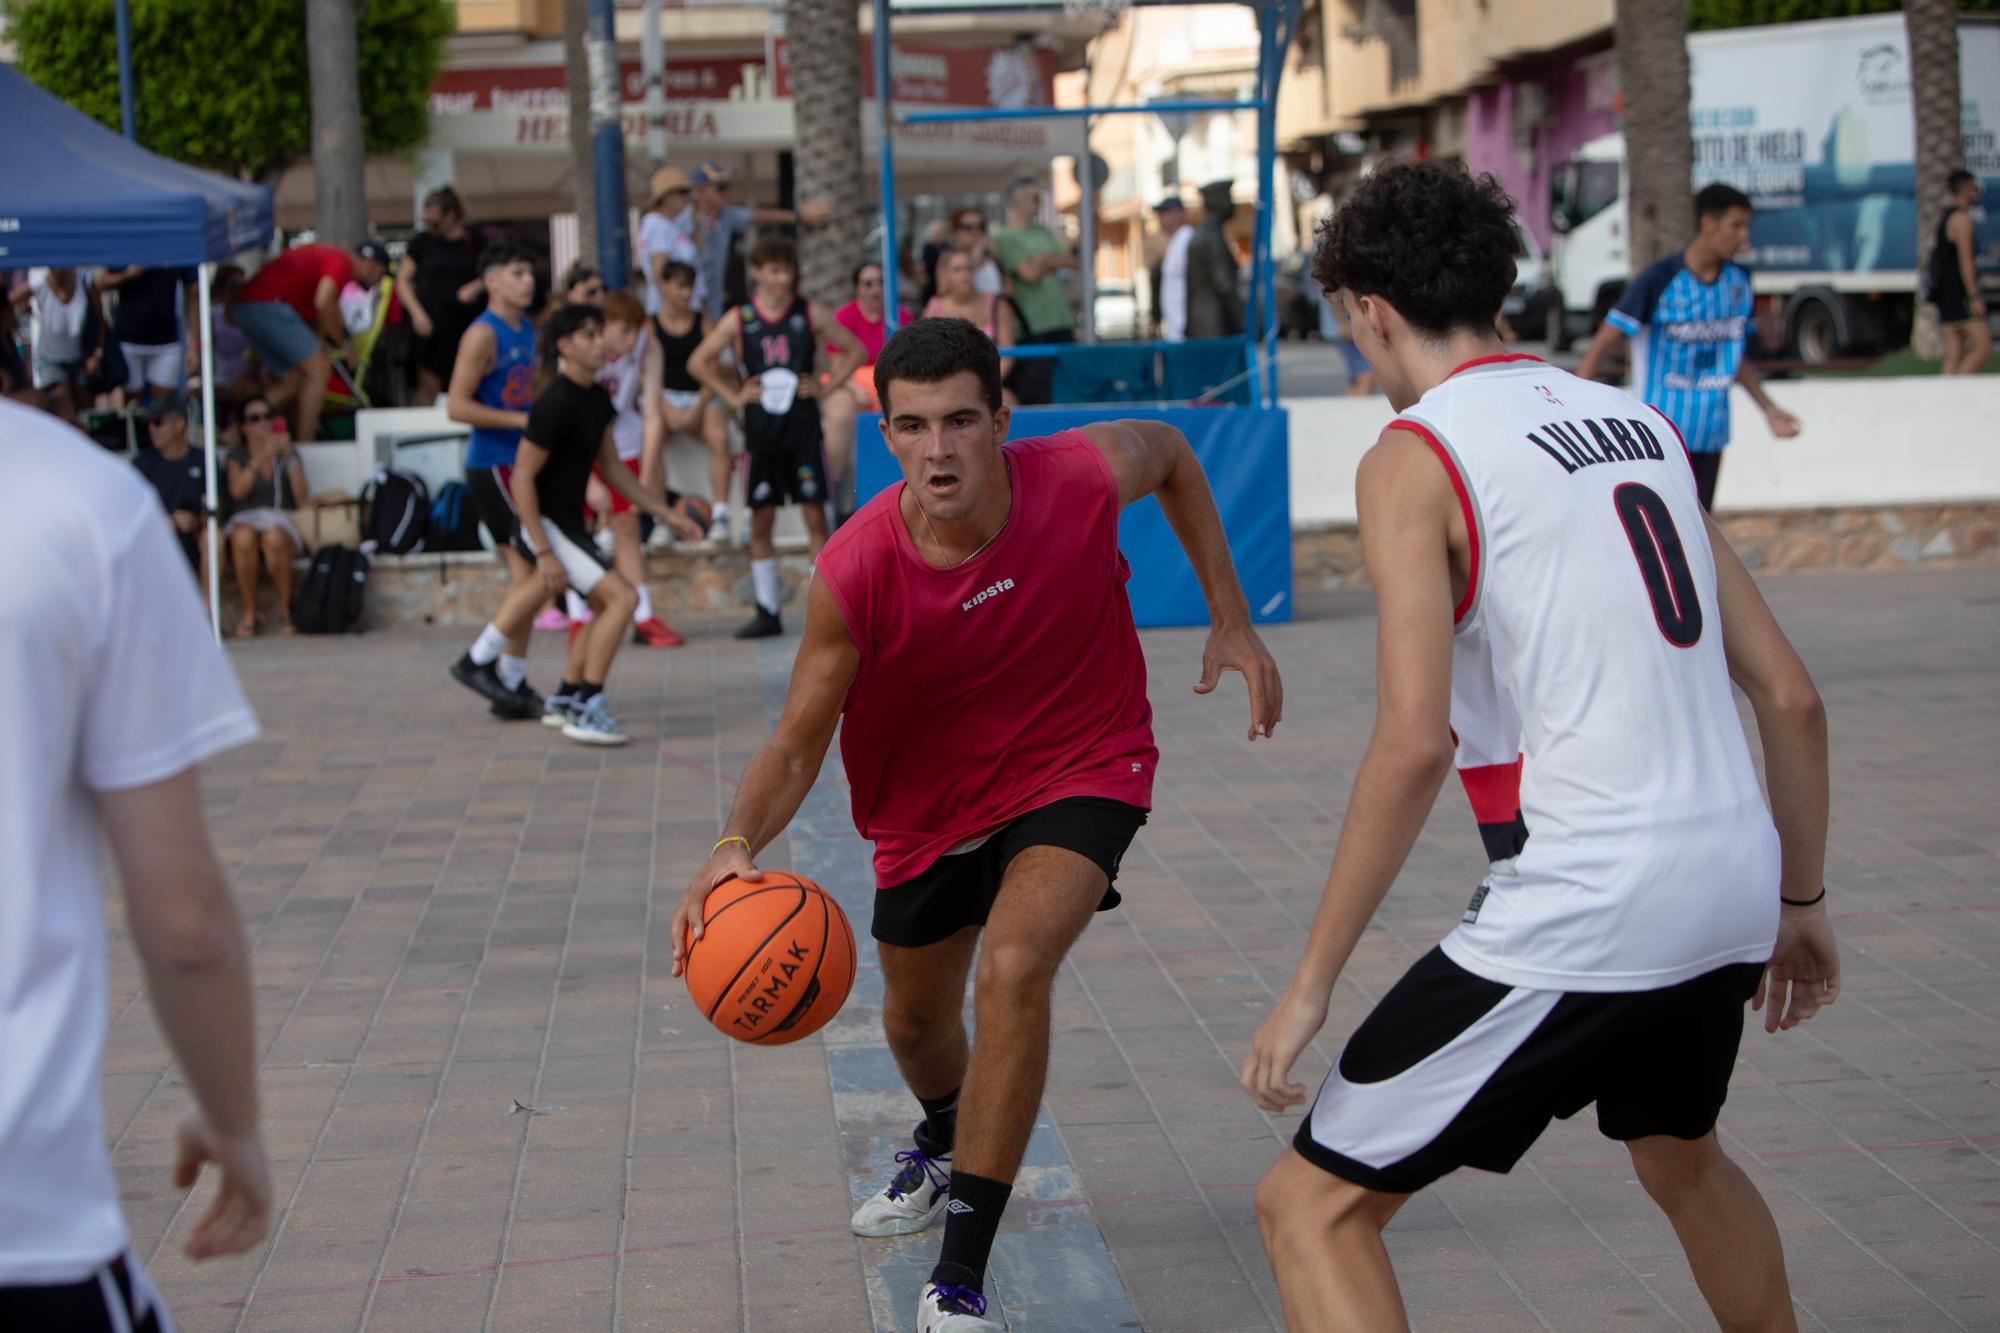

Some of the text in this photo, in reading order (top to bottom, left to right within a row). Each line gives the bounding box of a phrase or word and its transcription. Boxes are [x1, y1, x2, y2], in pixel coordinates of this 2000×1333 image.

[761, 333, 791, 364] 14
[1526, 416, 1665, 475] LILLARD
[1612, 481, 1703, 648] 0
[962, 578, 1015, 612] kipsta
[733, 939, 810, 1031] TARMAK
